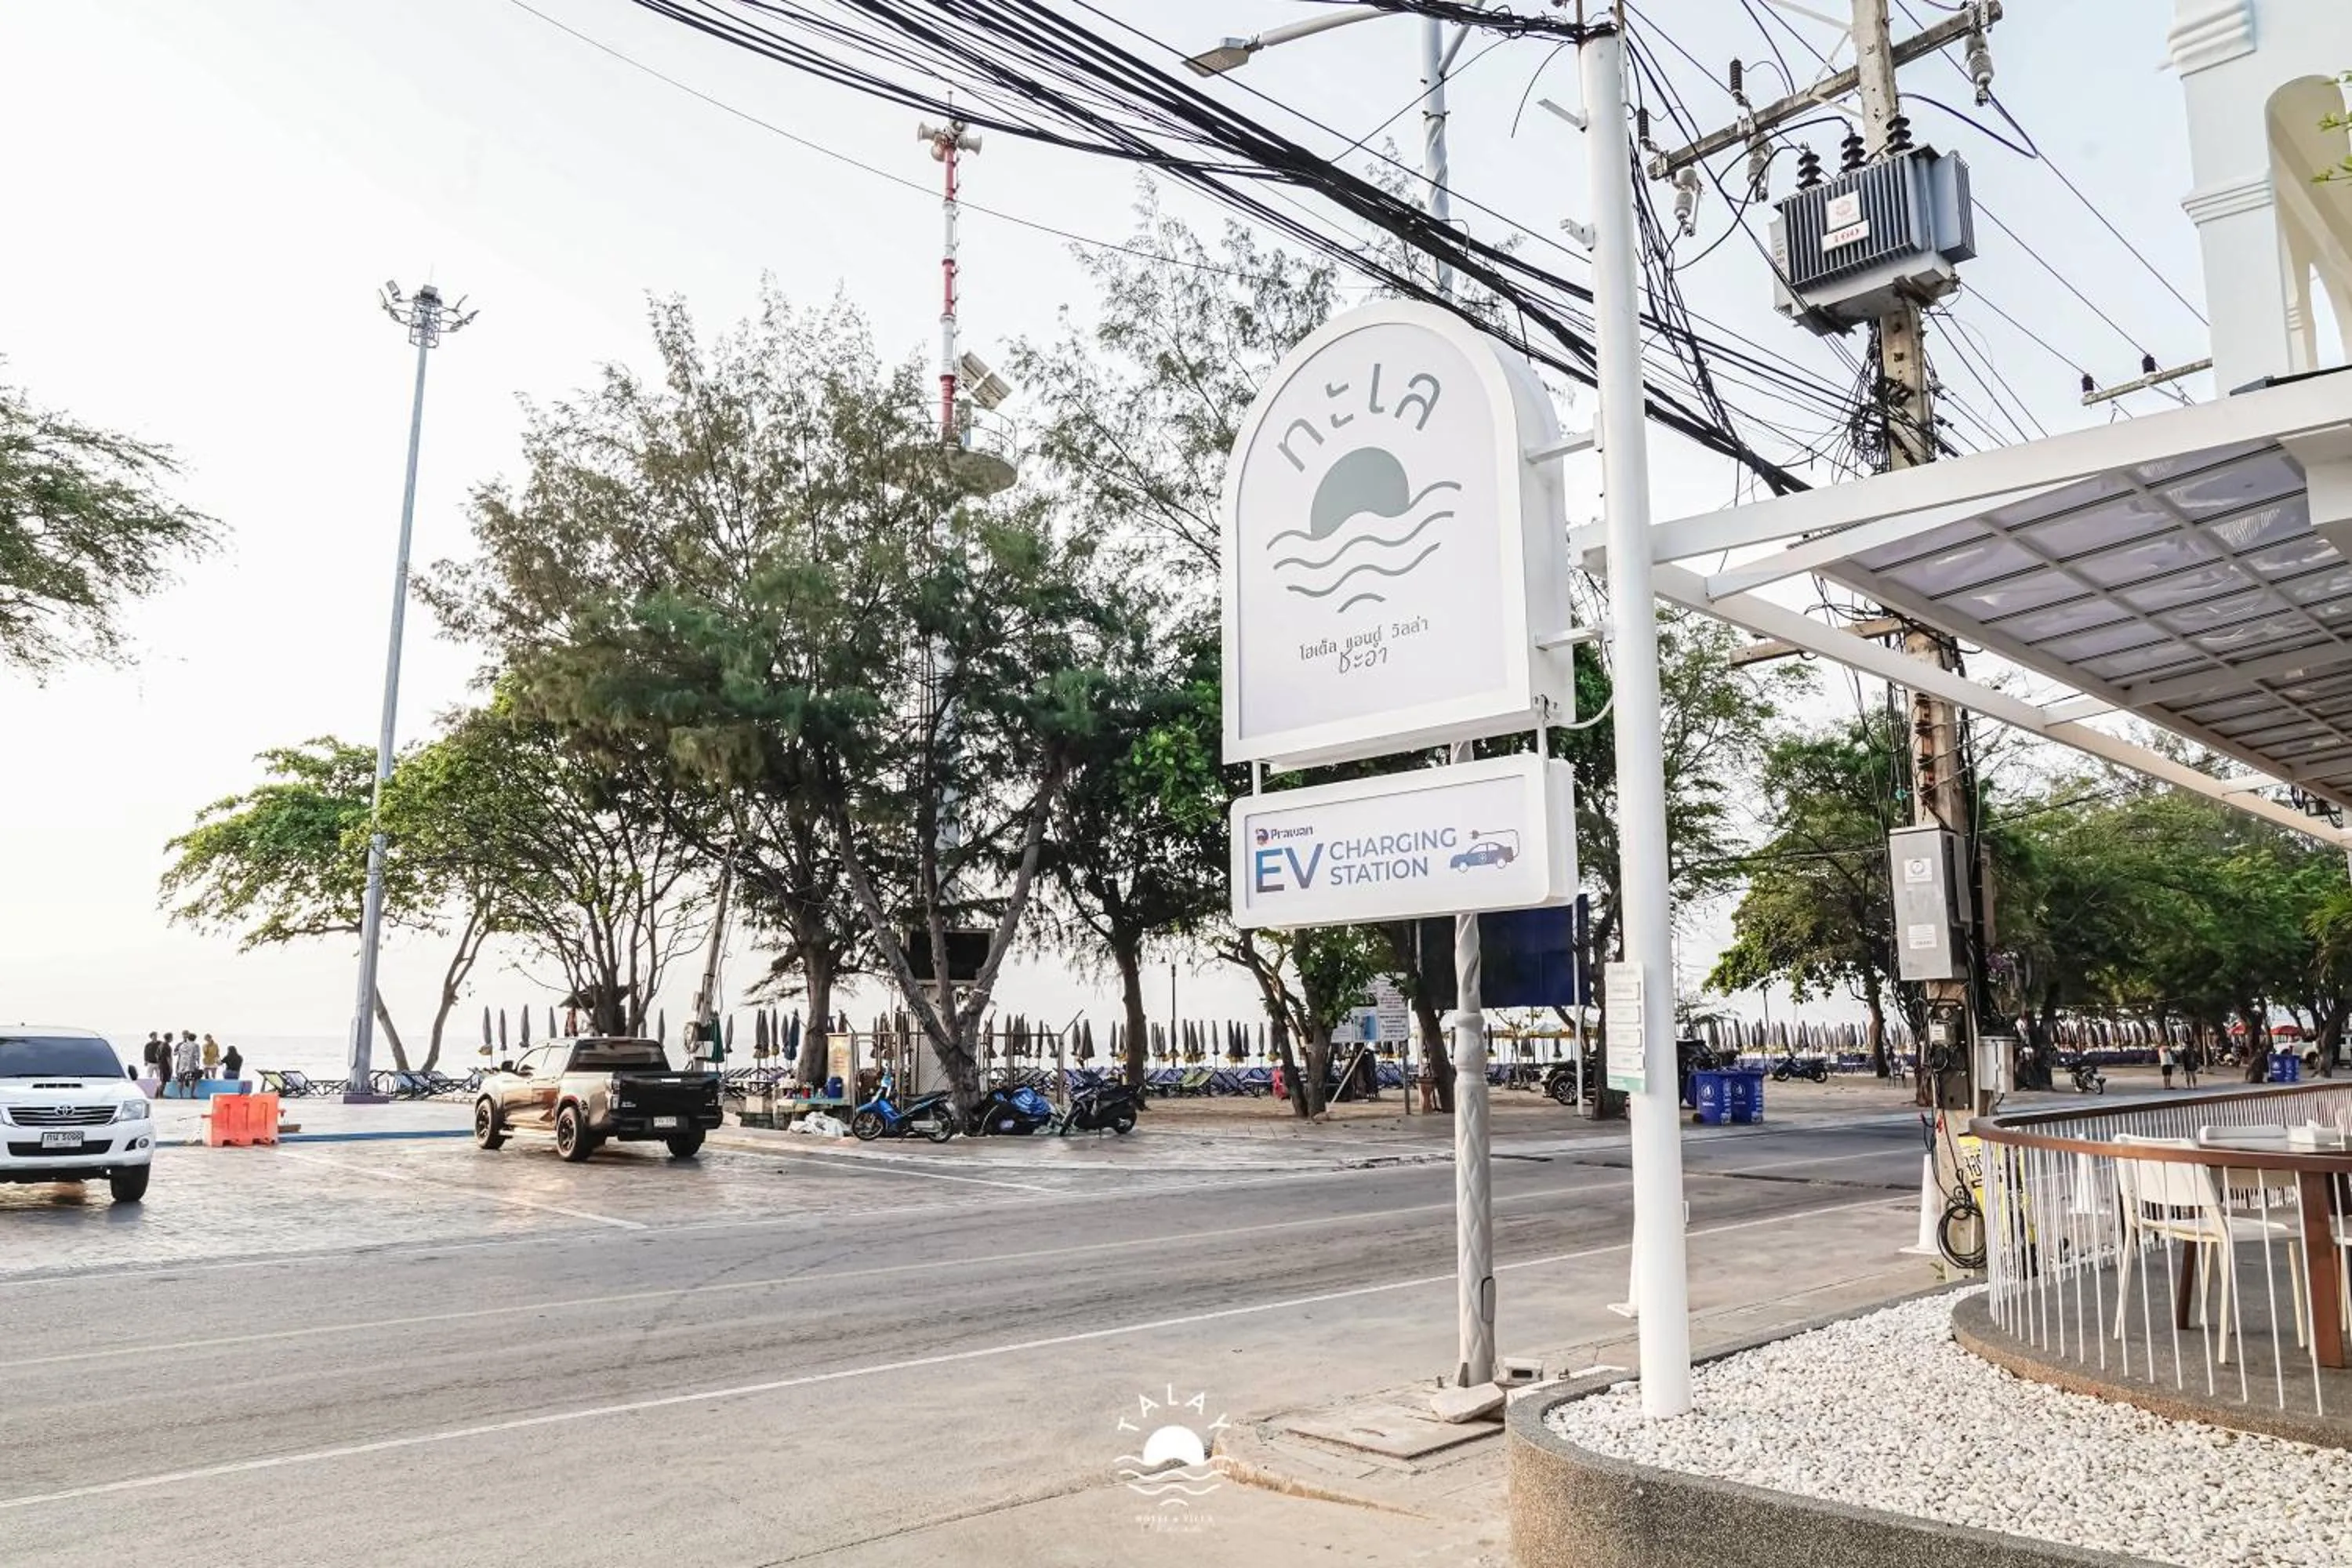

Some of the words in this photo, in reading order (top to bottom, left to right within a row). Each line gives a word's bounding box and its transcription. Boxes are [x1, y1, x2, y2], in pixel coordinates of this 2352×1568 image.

[1277, 363, 1441, 473] ทะเล
[1391, 615, 1428, 639] วิลล่า
[1329, 827, 1457, 861] CHARGING
[1255, 843, 1324, 894] EV
[1330, 855, 1428, 886] STATION
